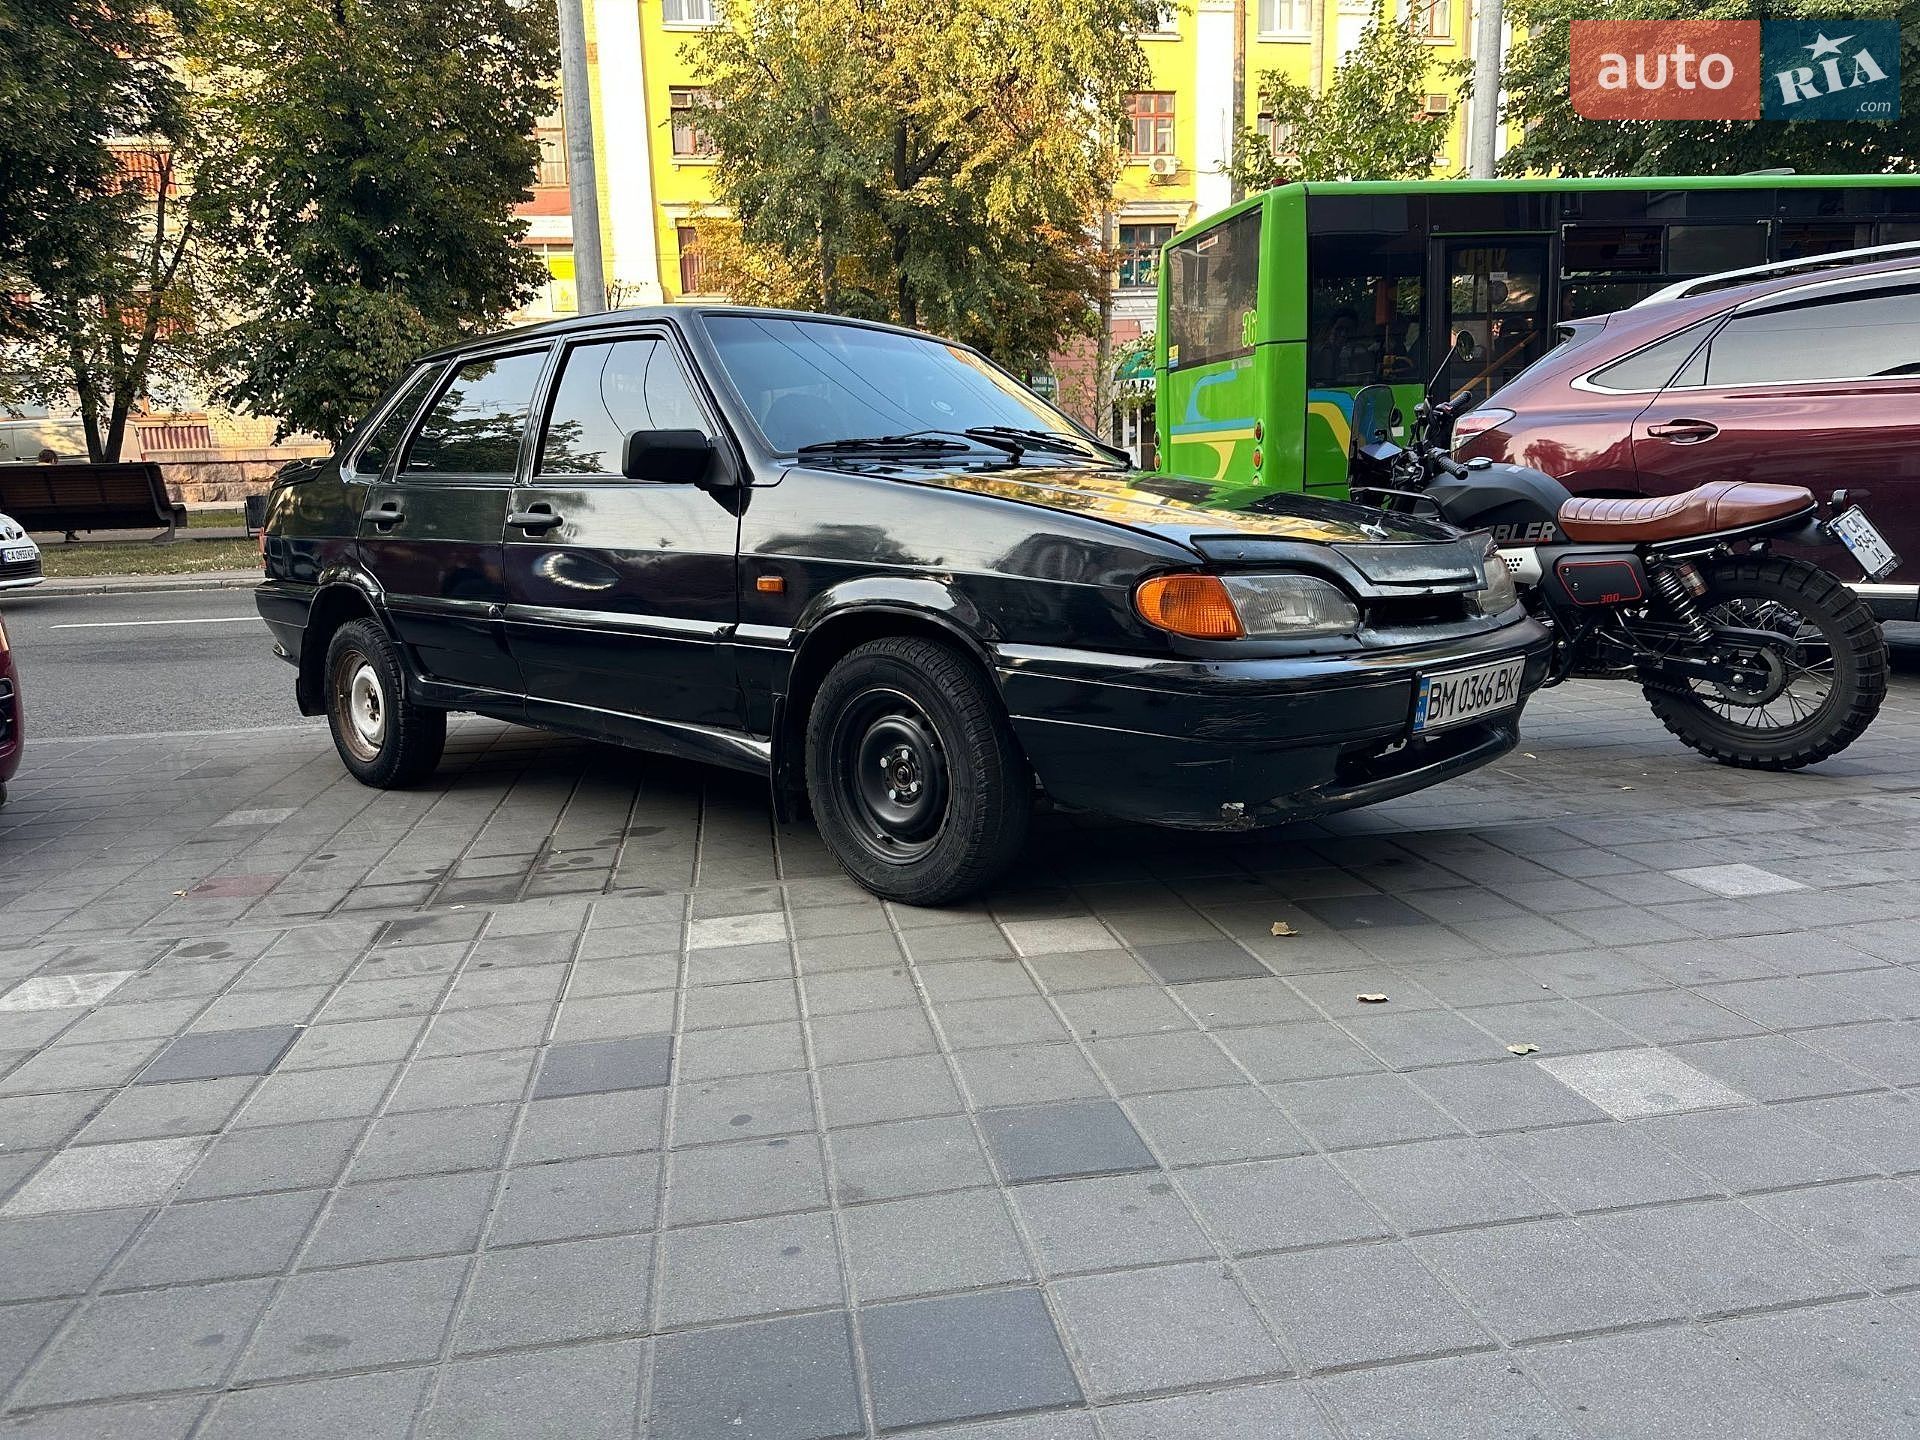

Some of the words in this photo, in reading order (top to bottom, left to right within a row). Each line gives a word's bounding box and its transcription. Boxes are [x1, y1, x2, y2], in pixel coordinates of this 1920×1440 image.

[1600, 593, 1619, 604] 300
[1427, 680, 1458, 721] BM
[1459, 671, 1496, 713] 0366
[1495, 665, 1521, 704] BK
[1415, 711, 1424, 723] UA
